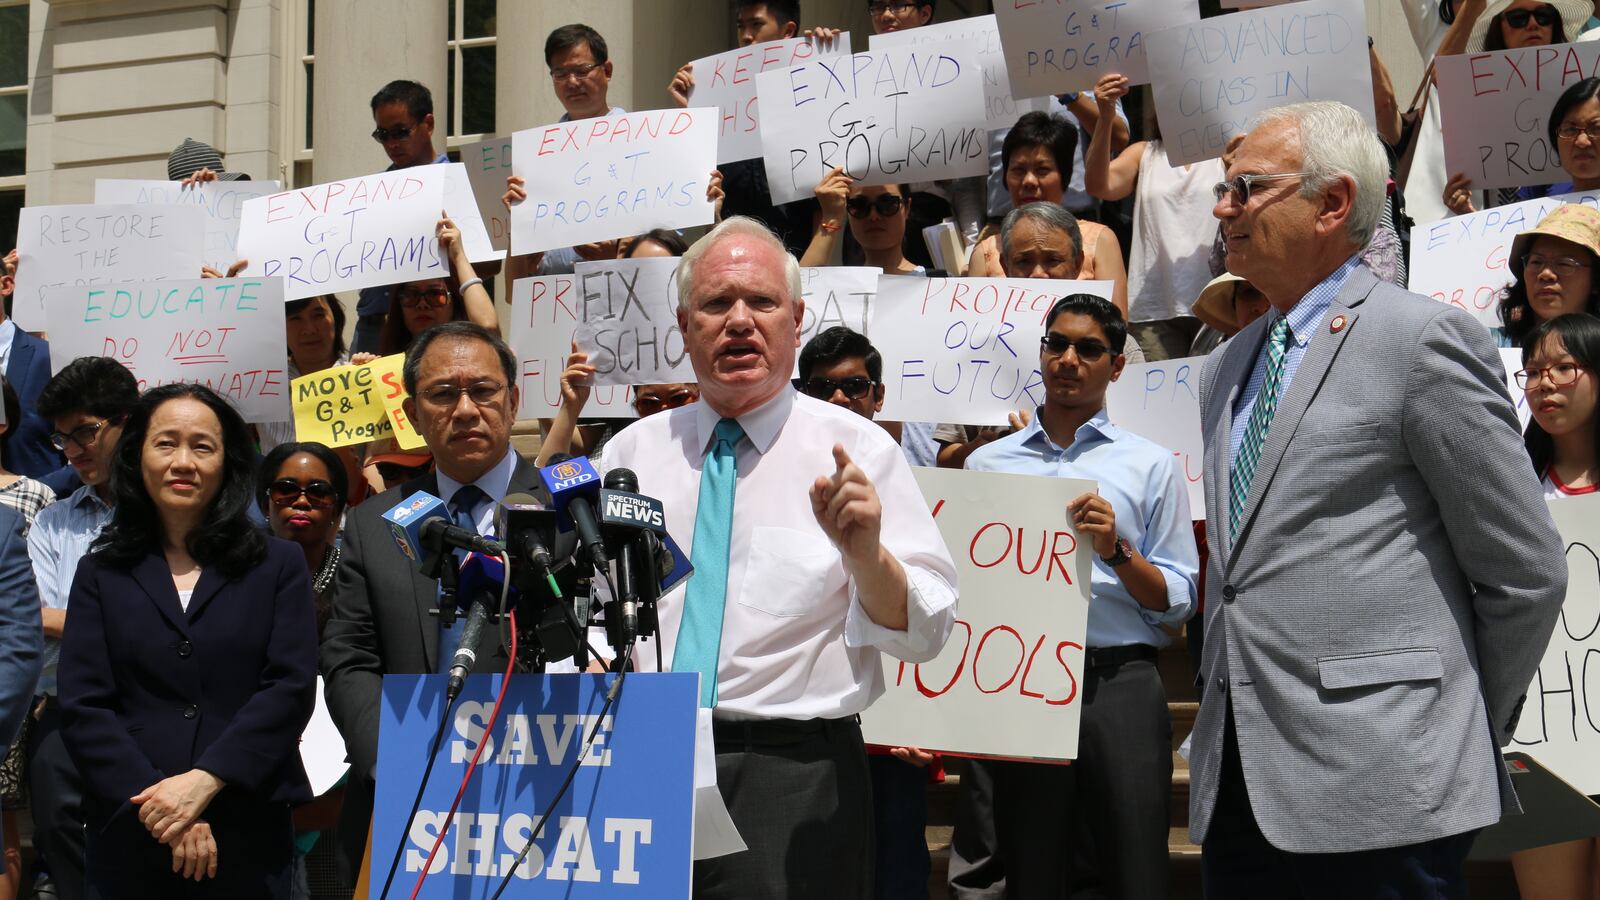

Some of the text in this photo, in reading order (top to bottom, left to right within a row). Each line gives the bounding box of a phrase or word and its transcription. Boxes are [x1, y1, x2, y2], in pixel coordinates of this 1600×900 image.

[1026, 32, 1146, 76] PROGRA
[1180, 12, 1352, 70] ADVANCED
[790, 53, 960, 107] EXPAND
[1179, 65, 1310, 117] CLASS IN
[537, 112, 693, 156] EXPAND
[790, 127, 984, 191] PROGRAMS
[137, 186, 262, 220] ADVANCE
[267, 177, 423, 224] EXPAND
[533, 181, 697, 232] PROGRAMS
[39, 215, 164, 247] RESTORE
[74, 247, 120, 270] THE
[264, 235, 441, 288] PROGRAMS
[84, 281, 262, 322] EDUCATE
[582, 267, 652, 322] FIX
[102, 327, 237, 359] DO NOT
[944, 320, 1018, 358] OUR
[900, 359, 1046, 407] FUTUR
[554, 473, 593, 490] NTD
[607, 494, 651, 509] SPECTRUM
[606, 501, 663, 526] NEWS
[969, 522, 1077, 585] OUR
[450, 700, 614, 767] SAVE
[405, 809, 652, 885] SHSAT
